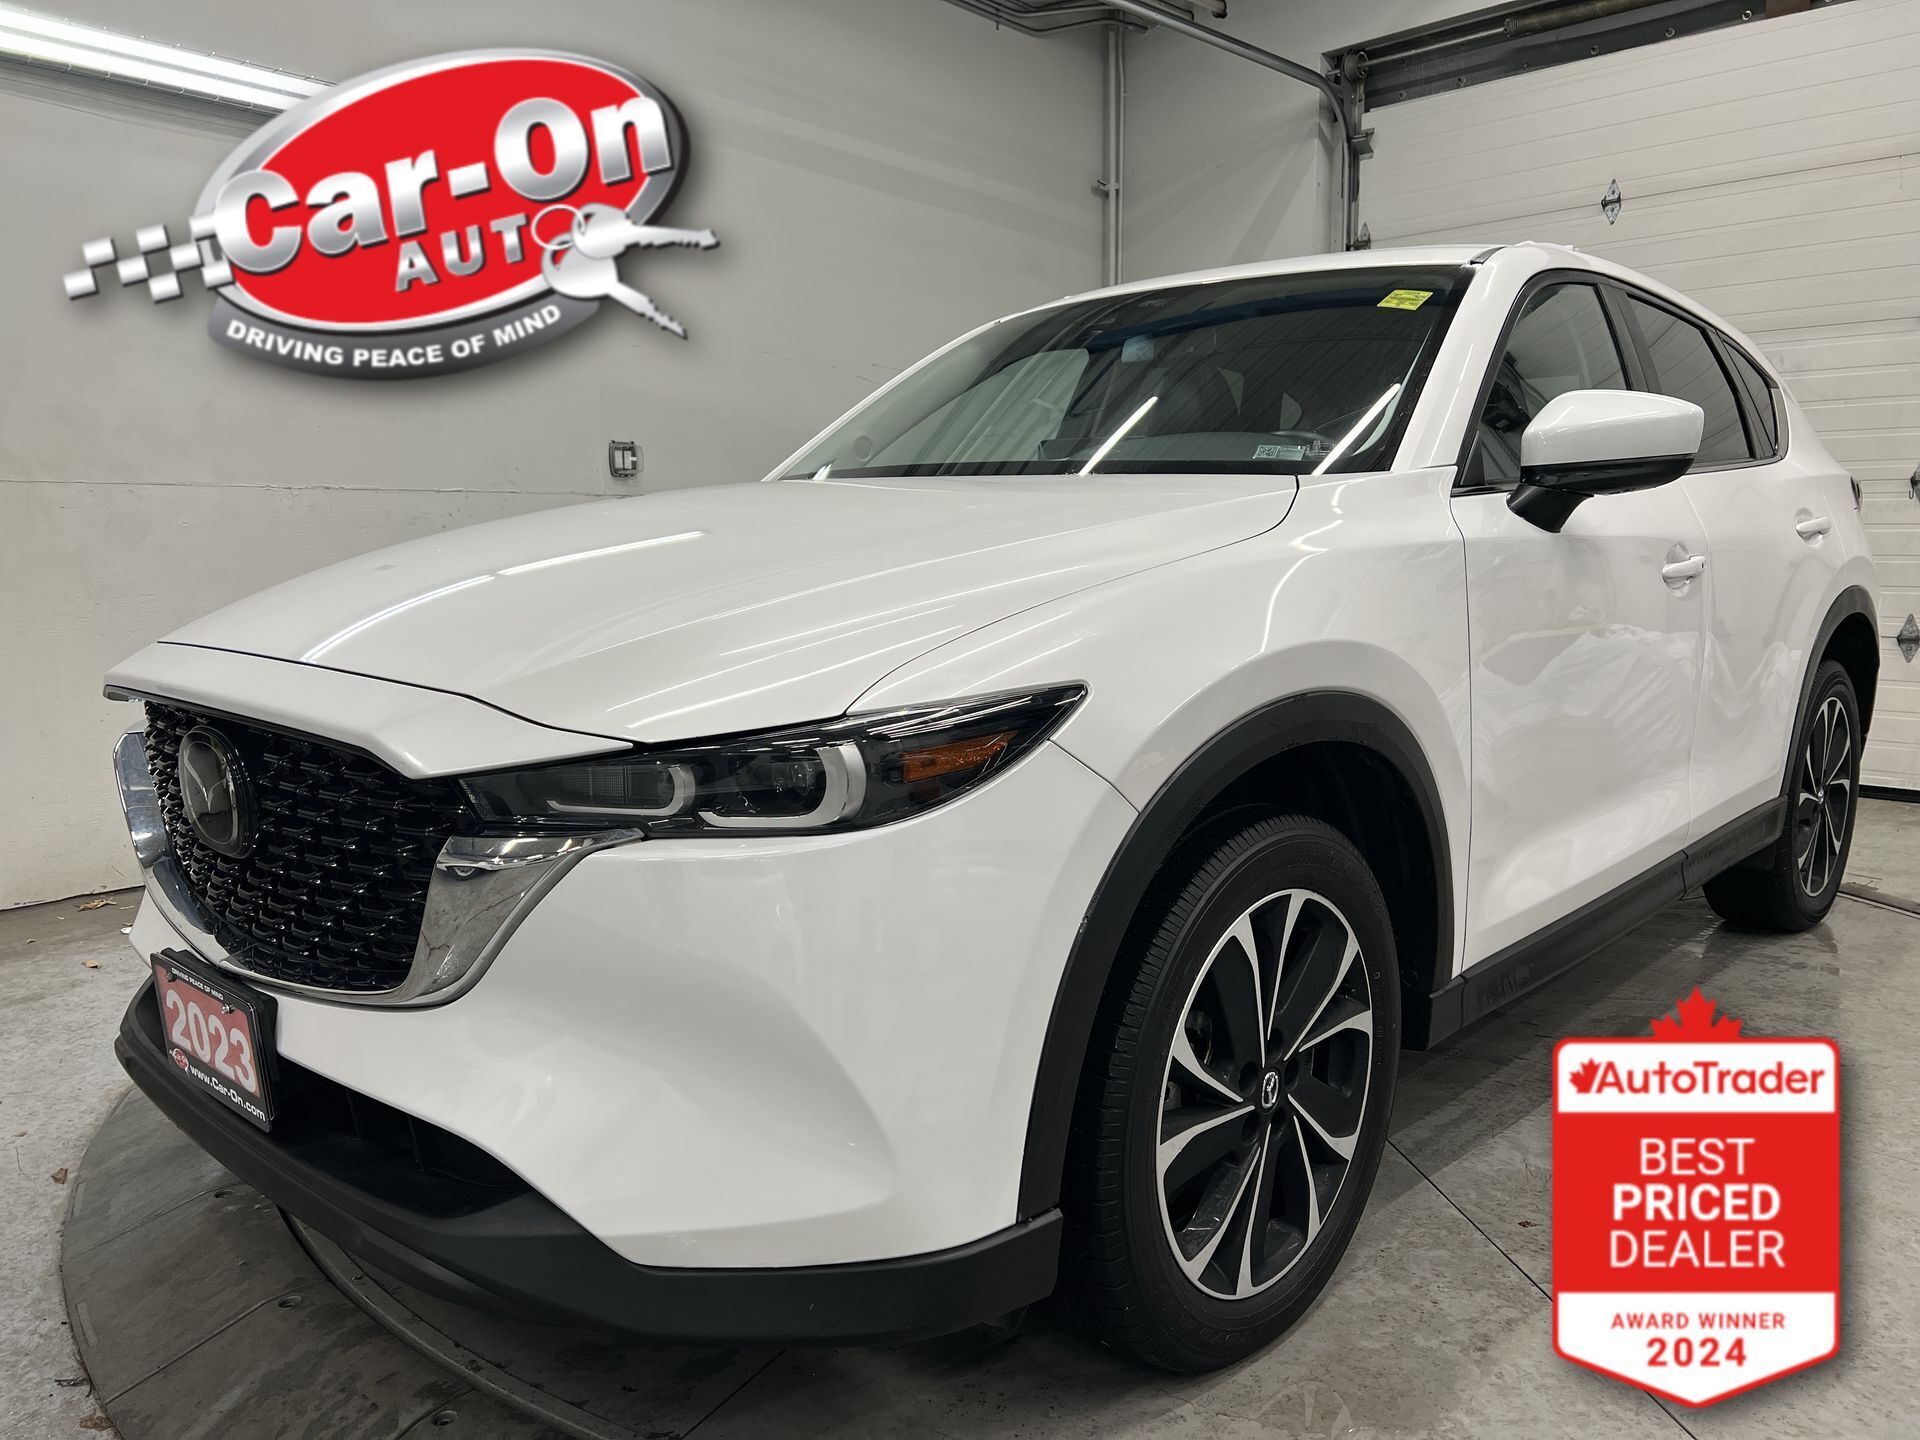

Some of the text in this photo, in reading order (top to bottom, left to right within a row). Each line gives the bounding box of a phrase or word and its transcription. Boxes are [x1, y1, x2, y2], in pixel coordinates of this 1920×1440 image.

[189, 977, 204, 990] PEACE
[166, 989, 258, 1093] 2023
[190, 1064, 266, 1122] www.Car-On.com
